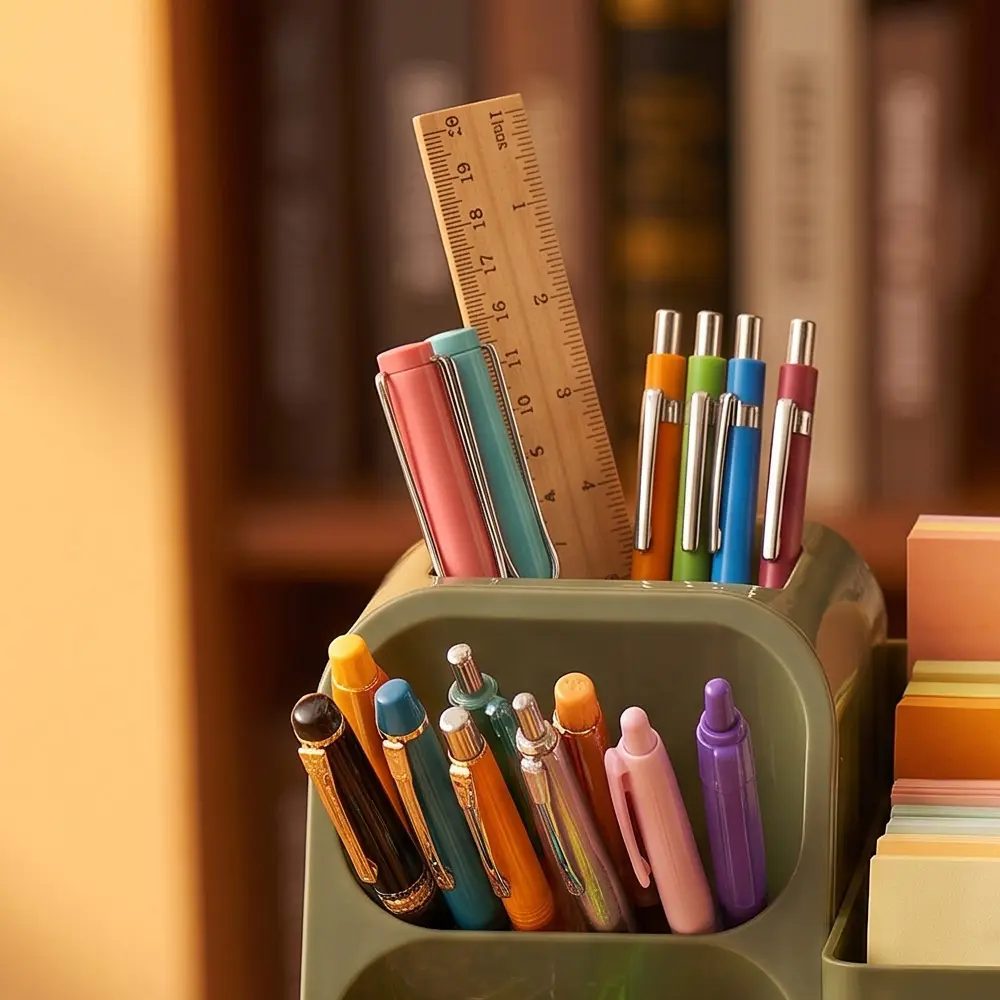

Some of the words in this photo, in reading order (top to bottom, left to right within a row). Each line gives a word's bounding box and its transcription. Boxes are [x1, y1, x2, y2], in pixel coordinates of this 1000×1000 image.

[456, 161, 474, 184] 19
[469, 207, 486, 230] 18
[479, 254, 497, 275] 17
[492, 300, 510, 322] 16
[512, 201, 526, 212] 1
[533, 293, 549, 306] 2
[557, 386, 572, 399] 3
[581, 480, 596, 492] 4
[504, 348, 522, 369] 11
[518, 394, 534, 416] 10
